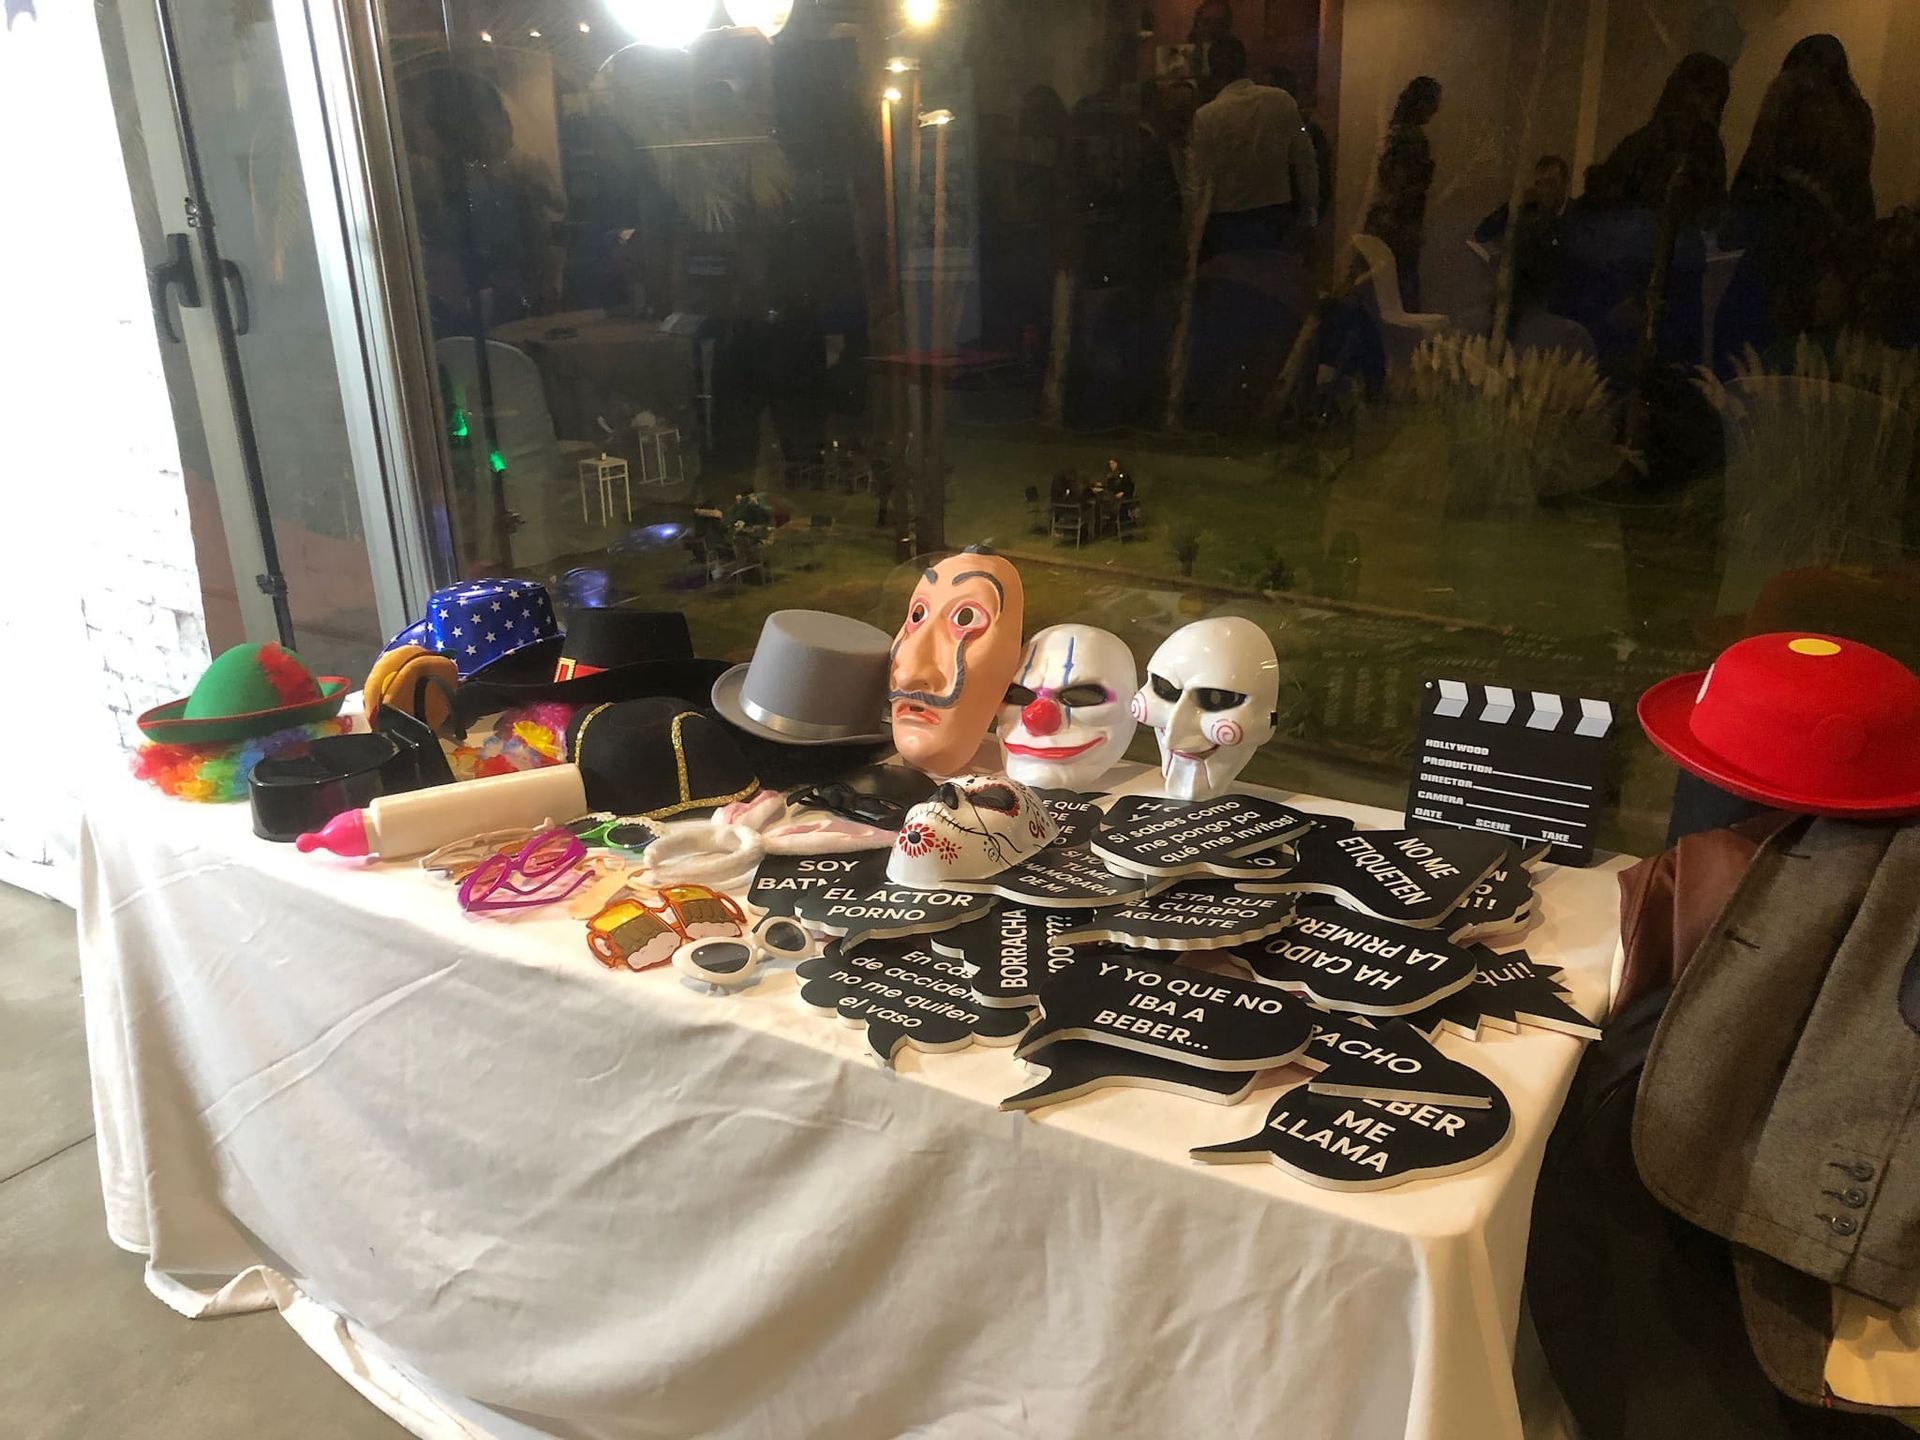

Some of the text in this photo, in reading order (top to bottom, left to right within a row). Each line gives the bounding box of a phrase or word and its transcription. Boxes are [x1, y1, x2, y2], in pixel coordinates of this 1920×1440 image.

[1425, 738, 1489, 756] HOLLYWOOD
[1422, 755, 1493, 774] PRODUCTION
[1420, 772, 1473, 788] DIRECTOR
[1055, 801, 1091, 811] QUE
[1417, 790, 1464, 805] CAMERA
[1108, 831, 1129, 844] Si
[1129, 816, 1187, 838] sabes
[1187, 801, 1241, 821] como
[1133, 810, 1261, 854] me pongo pa
[1414, 807, 1570, 842] DATE SCENE TAKE
[1160, 815, 1299, 864] qué me invitas!
[797, 860, 859, 872] SOY
[1062, 861, 1115, 880] TU ME
[1336, 836, 1432, 906] ETIQUETEN
[1393, 837, 1461, 879] NO ME
[1019, 875, 1068, 893] DE MI
[1020, 861, 1118, 896] NAMORARIA
[823, 888, 973, 907] EL ACTOR
[1158, 902, 1260, 918] CUERPO
[1170, 892, 1278, 909] STA QUE
[827, 905, 926, 920] PORNO
[1113, 910, 1240, 929] AGUANTE
[901, 951, 932, 965] En
[1000, 908, 1028, 988] BORRACHA
[1405, 948, 1449, 971] LA
[851, 957, 884, 970] de
[1265, 939, 1403, 990] HA CAIDO
[828, 971, 980, 1024] no me quiten
[1099, 962, 1283, 1014] Y YO QUE NO
[838, 996, 923, 1028] el vaso
[1128, 993, 1205, 1023] IBA A
[1093, 1009, 1209, 1050] BEBER...
[1333, 1109, 1396, 1144] ME
[1268, 1111, 1390, 1173] LLAMA
